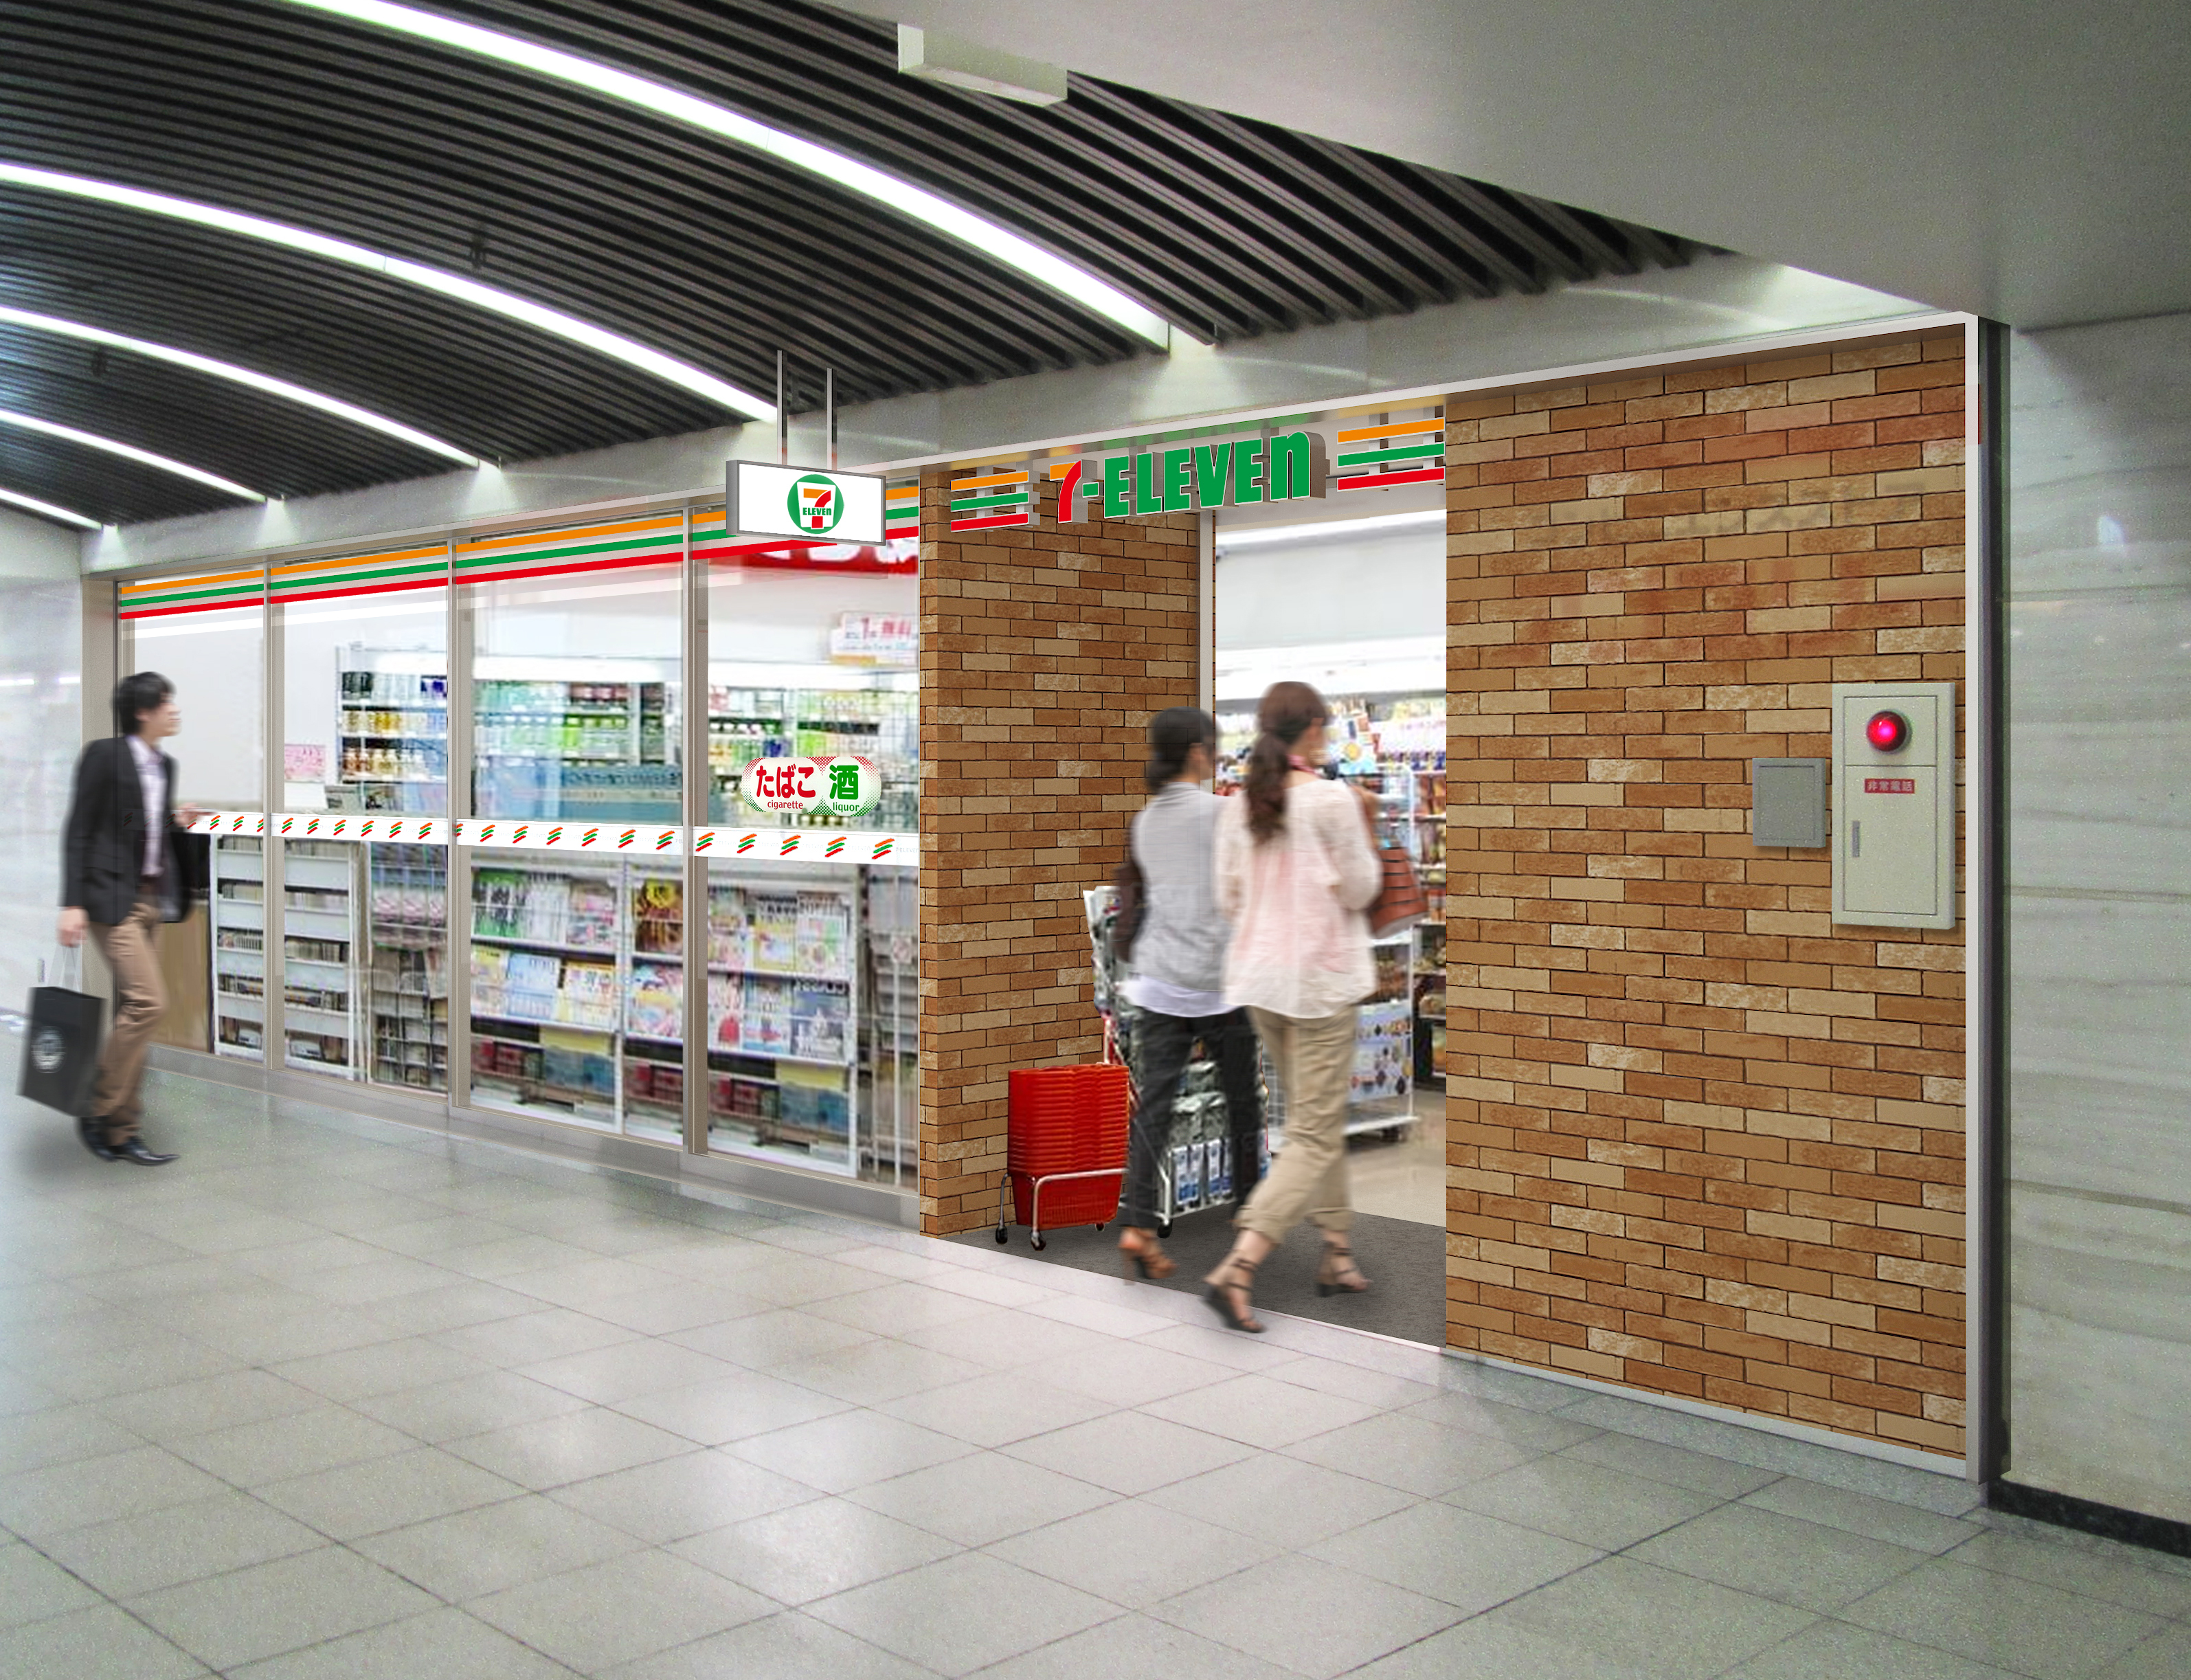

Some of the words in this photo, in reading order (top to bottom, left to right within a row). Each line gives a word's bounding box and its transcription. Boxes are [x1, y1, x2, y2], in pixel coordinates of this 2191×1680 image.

[756, 763, 816, 798] たばこ
[829, 764, 859, 800] 酒
[767, 800, 804, 809] cigarette
[833, 802, 859, 812] liquor
